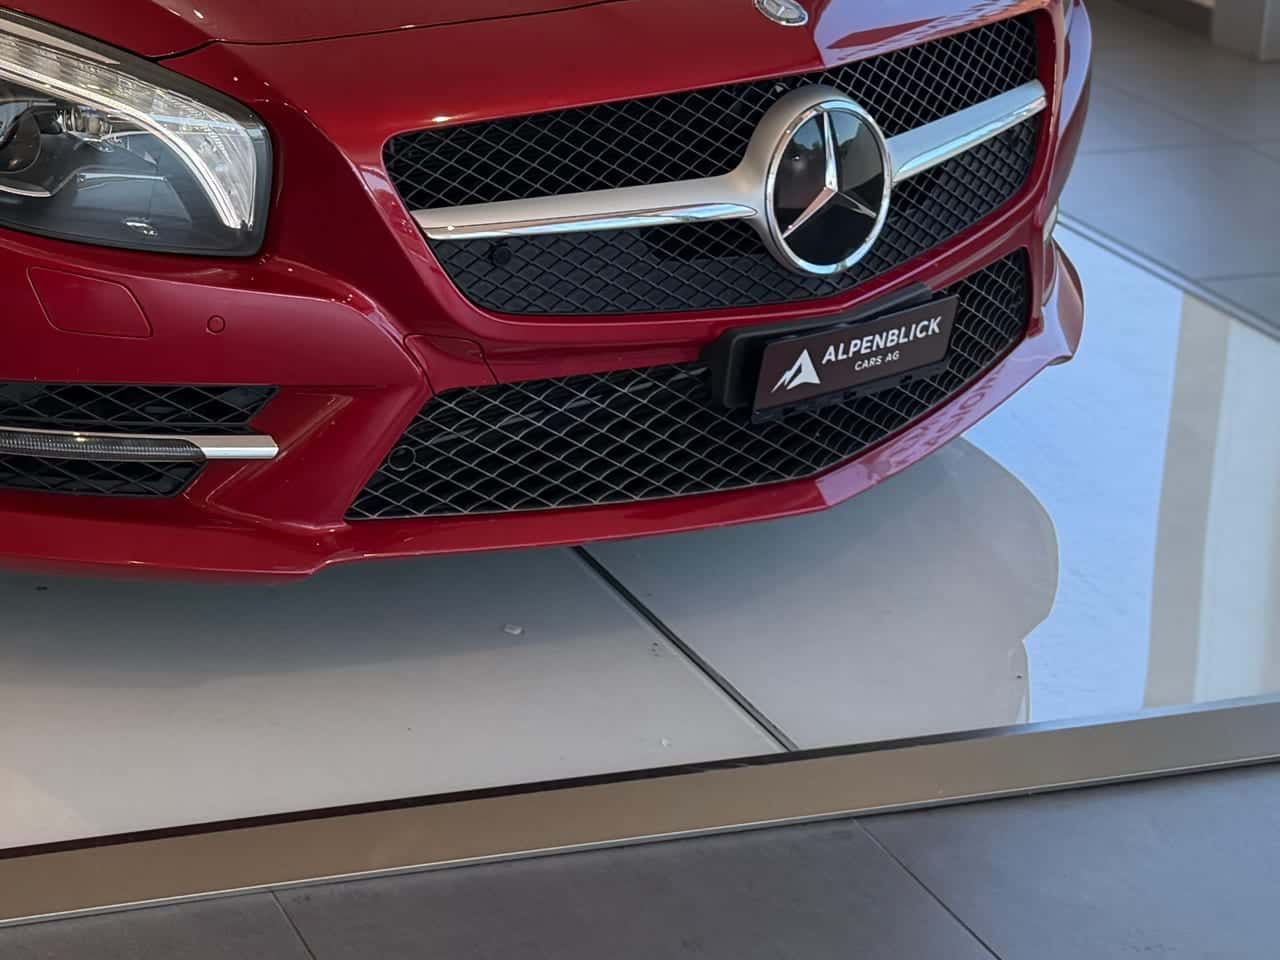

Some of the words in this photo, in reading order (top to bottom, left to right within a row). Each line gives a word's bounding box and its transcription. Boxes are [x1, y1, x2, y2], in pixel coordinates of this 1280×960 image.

[822, 316, 941, 364] ALPENBLICK
[853, 355, 882, 371] CARS
[884, 349, 900, 363] AG
